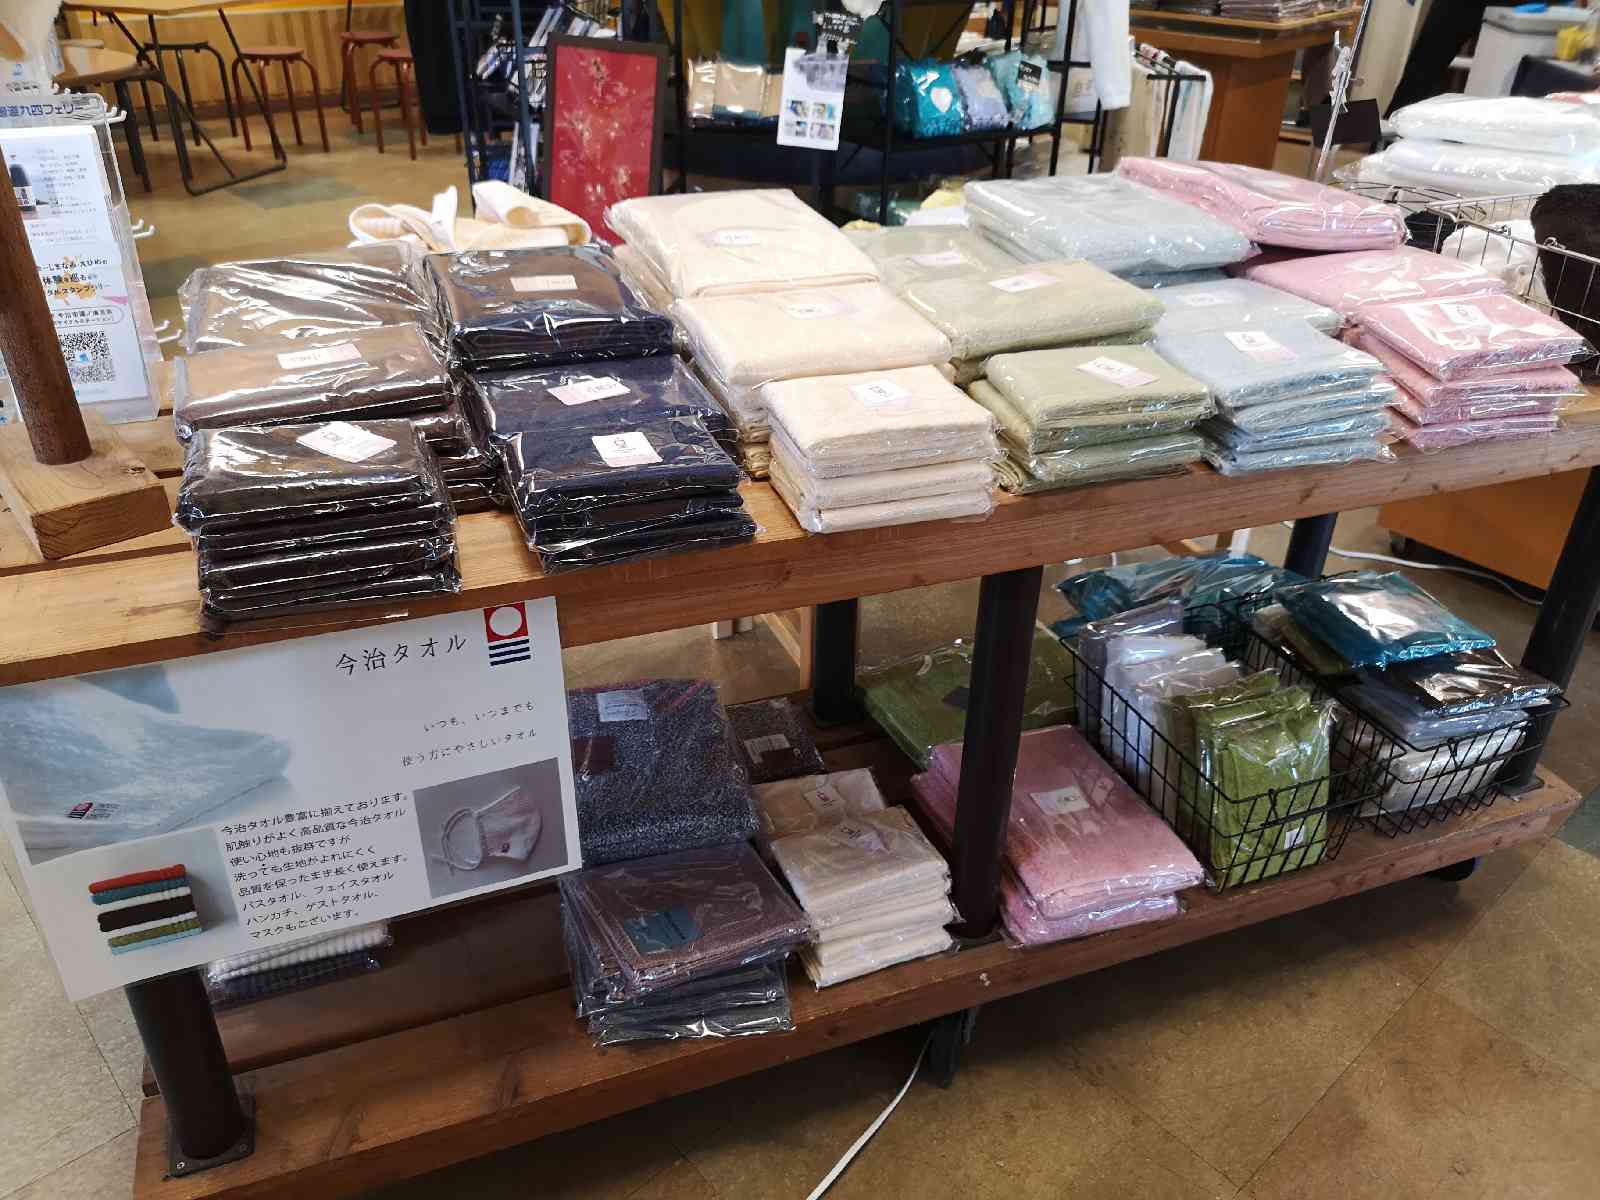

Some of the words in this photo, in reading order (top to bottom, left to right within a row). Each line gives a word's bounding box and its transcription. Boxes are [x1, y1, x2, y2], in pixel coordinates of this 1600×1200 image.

[335, 634, 467, 676] 今治タオル
[423, 701, 535, 732] いつも、いつまでも
[401, 728, 537, 767] 使う方にやさしいタオル
[222, 792, 407, 834] 今治タオル豊富に揃えております。
[225, 809, 406, 852] 肌触りがよく高品質な今治タオル
[229, 835, 350, 867] 使い心地も抜群ですが
[233, 846, 376, 882] 洗っても生地がよれにくく
[238, 854, 408, 897] 品質を保ったまま長く使えます。
[250, 911, 359, 938] マスクもございます。
